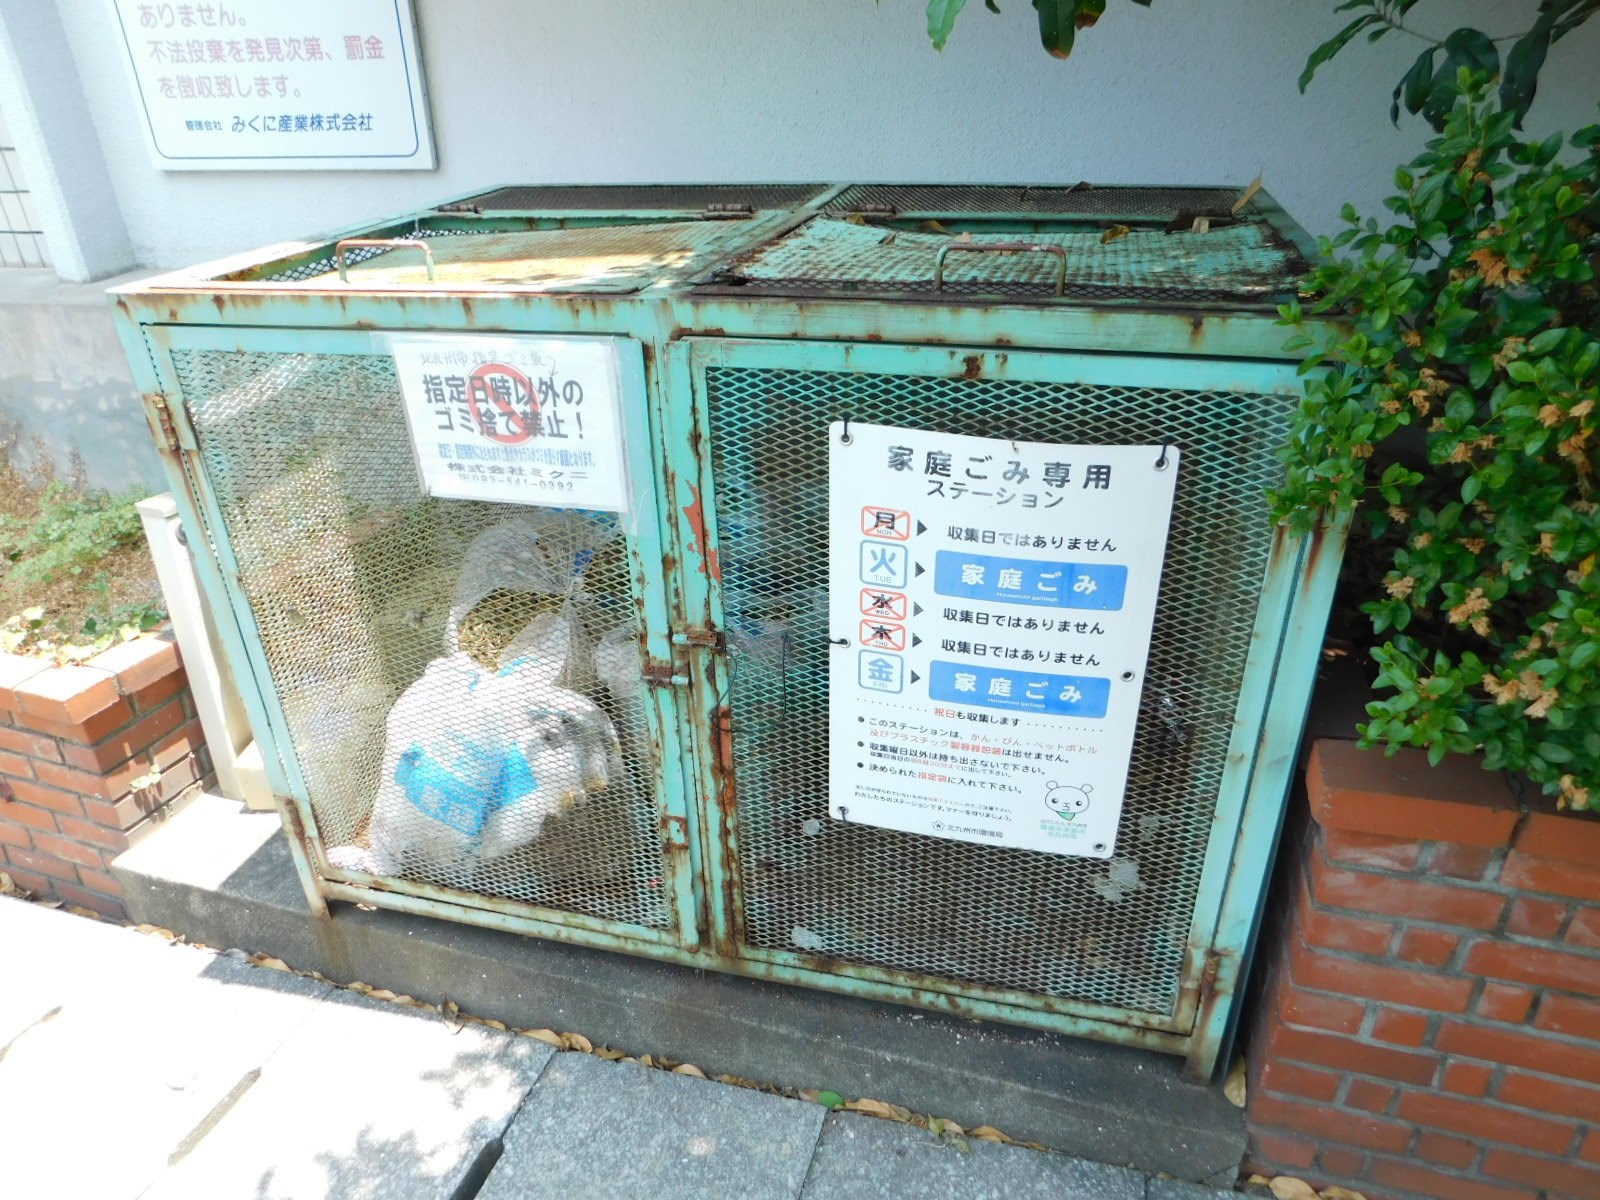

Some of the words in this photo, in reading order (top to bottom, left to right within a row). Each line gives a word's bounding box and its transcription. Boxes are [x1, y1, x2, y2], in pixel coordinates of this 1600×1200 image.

[137, 2, 247, 29] ありません。
[147, 35, 385, 64] 不法投棄を発見次第、罰金
[159, 74, 302, 99] を徴収致します。
[185, 120, 222, 132] 管理会社
[231, 113, 373, 134] みくに産業株式会社
[422, 374, 584, 407] 指定日時以外の
[434, 406, 584, 440] ゴミ捨て禁止！
[446, 462, 589, 480] 株式会社ミクニ
[887, 445, 1112, 490] 家庭ごみ専用
[926, 479, 1064, 509] ステーション
[873, 511, 896, 530] 月
[947, 525, 1118, 552] 収集日ではありません
[869, 548, 897, 577] 火
[874, 575, 892, 584] TUE
[960, 564, 1098, 595] 家庭ごみ
[943, 607, 1106, 635] 収集日ではありません
[941, 638, 1101, 667] 収集日ではありません
[867, 658, 893, 682] 金
[872, 681, 888, 689] FRI
[954, 672, 1082, 704] 家庭ごみ
[934, 707, 1021, 727] 祝日も収集します
